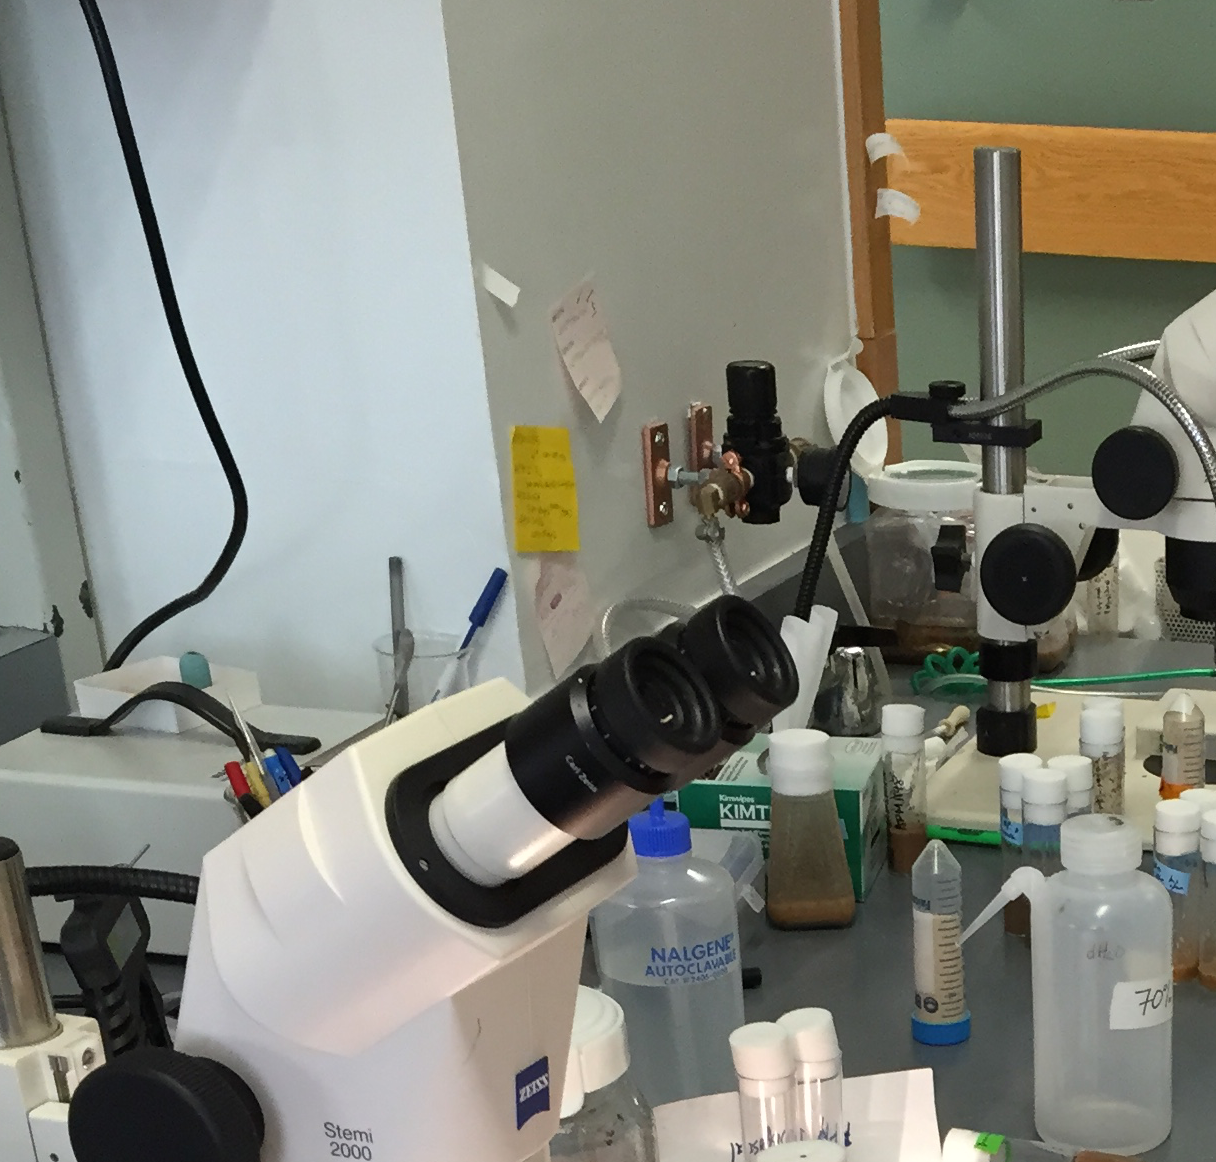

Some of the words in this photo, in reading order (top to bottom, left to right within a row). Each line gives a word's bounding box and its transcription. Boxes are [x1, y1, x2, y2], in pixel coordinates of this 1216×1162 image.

[565, 754, 581, 774] Carl
[578, 772, 598, 793] Zeiss
[718, 794, 755, 805] Kimwipes
[719, 803, 771, 820] KIMT
[651, 932, 733, 963] NALGENE
[645, 948, 737, 977] AUTOCLAVABLE
[1135, 980, 1172, 1016] 70%
[519, 1073, 549, 1103] ZEISS
[323, 1121, 374, 1144] Stemi
[329, 1141, 372, 1161] 2000
